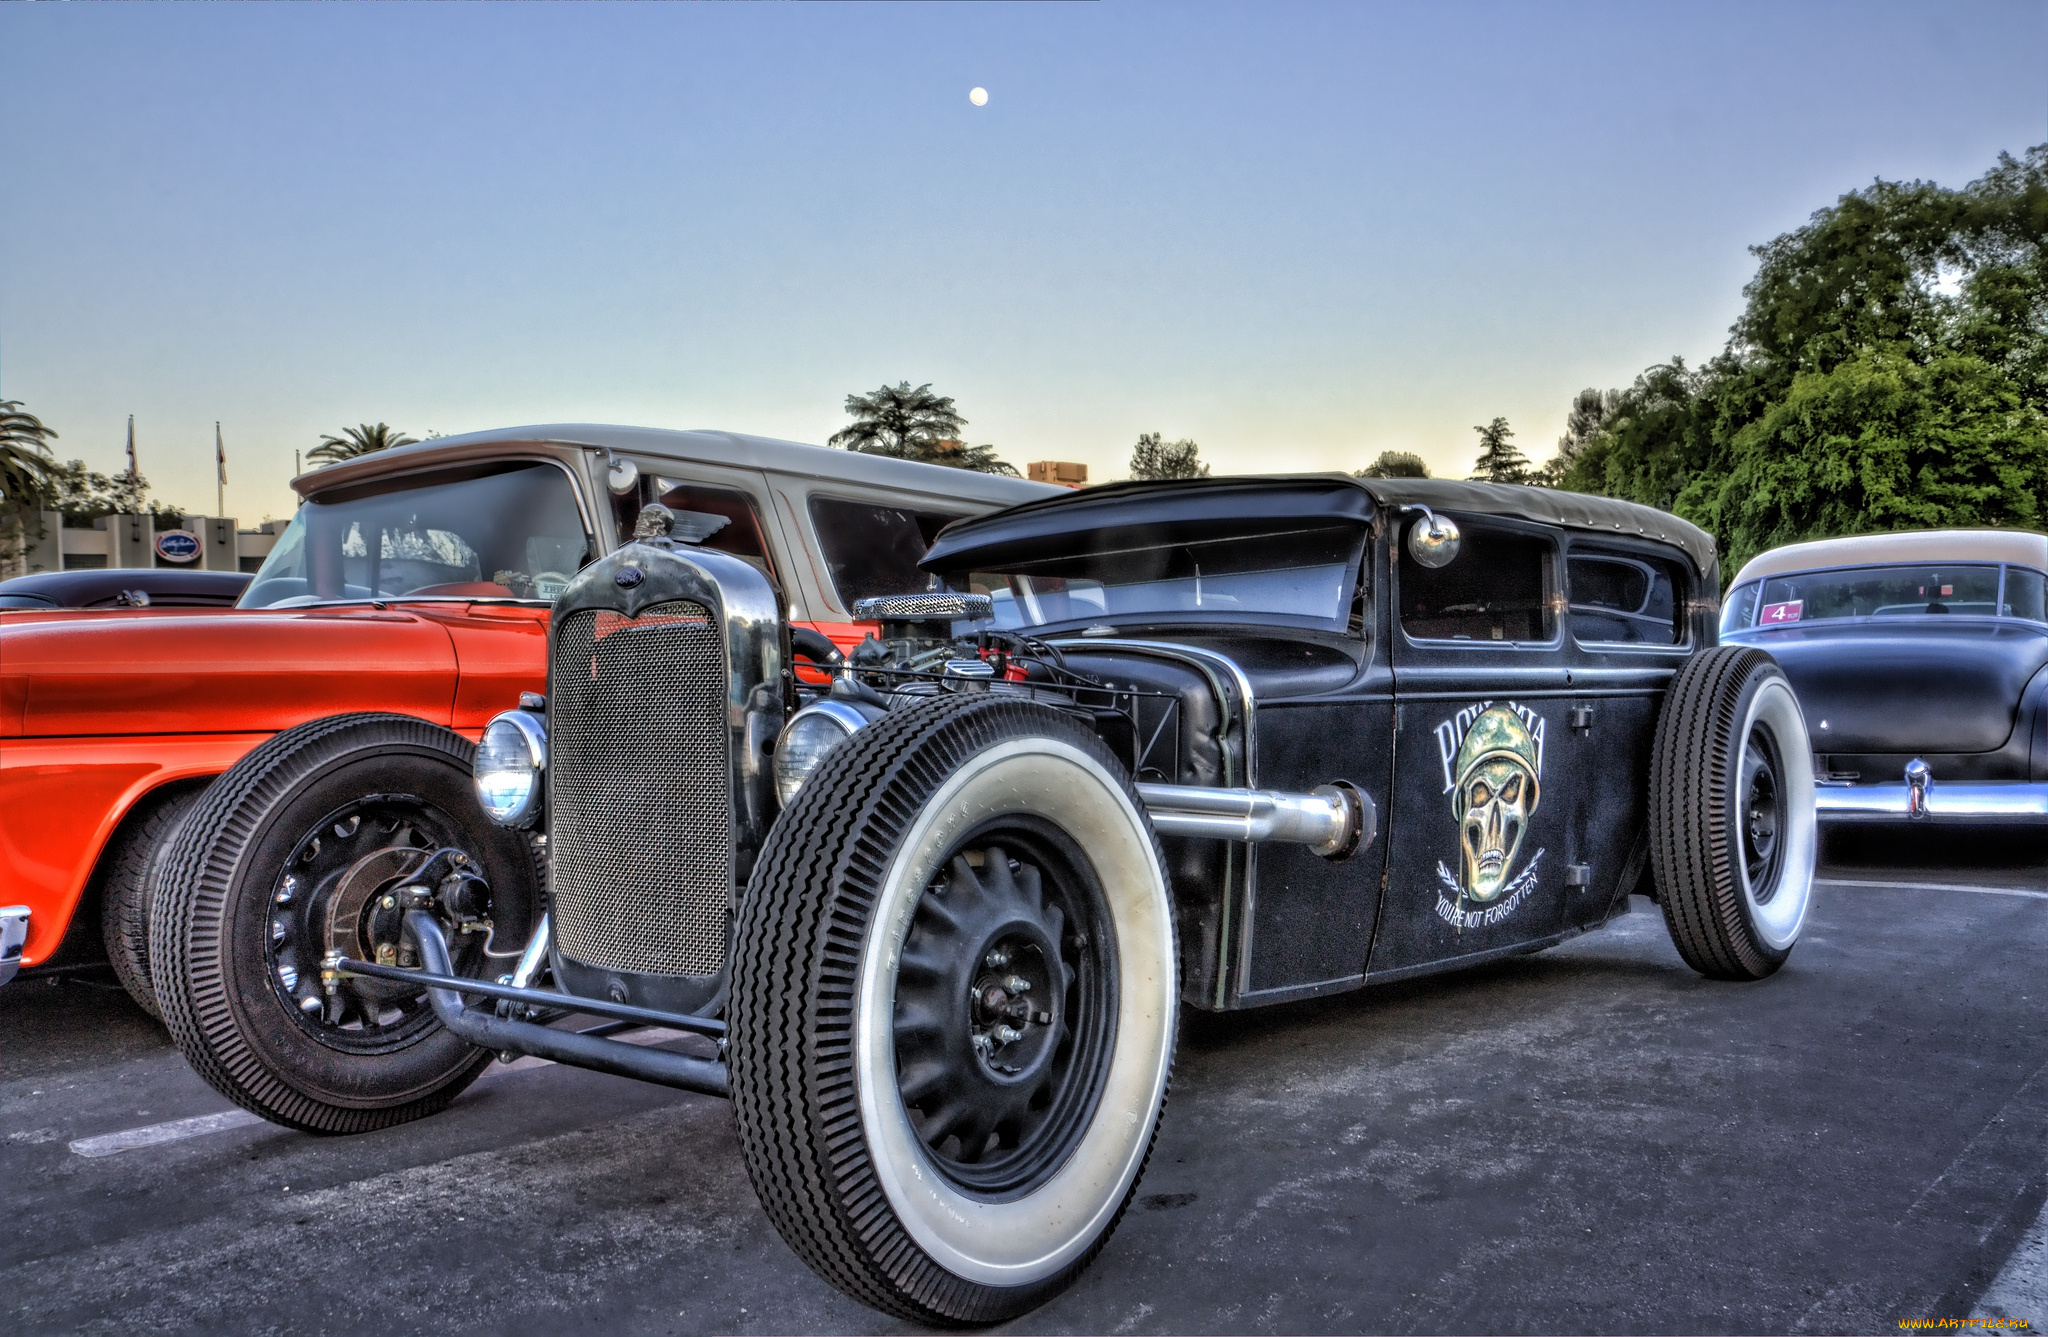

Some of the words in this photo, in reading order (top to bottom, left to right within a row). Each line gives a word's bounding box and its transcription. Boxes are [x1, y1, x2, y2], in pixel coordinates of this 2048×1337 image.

[1771, 606, 1786, 620] 4
[1433, 701, 1493, 795] PO
[1508, 701, 1546, 781] IA
[1464, 911, 1484, 928] NOT
